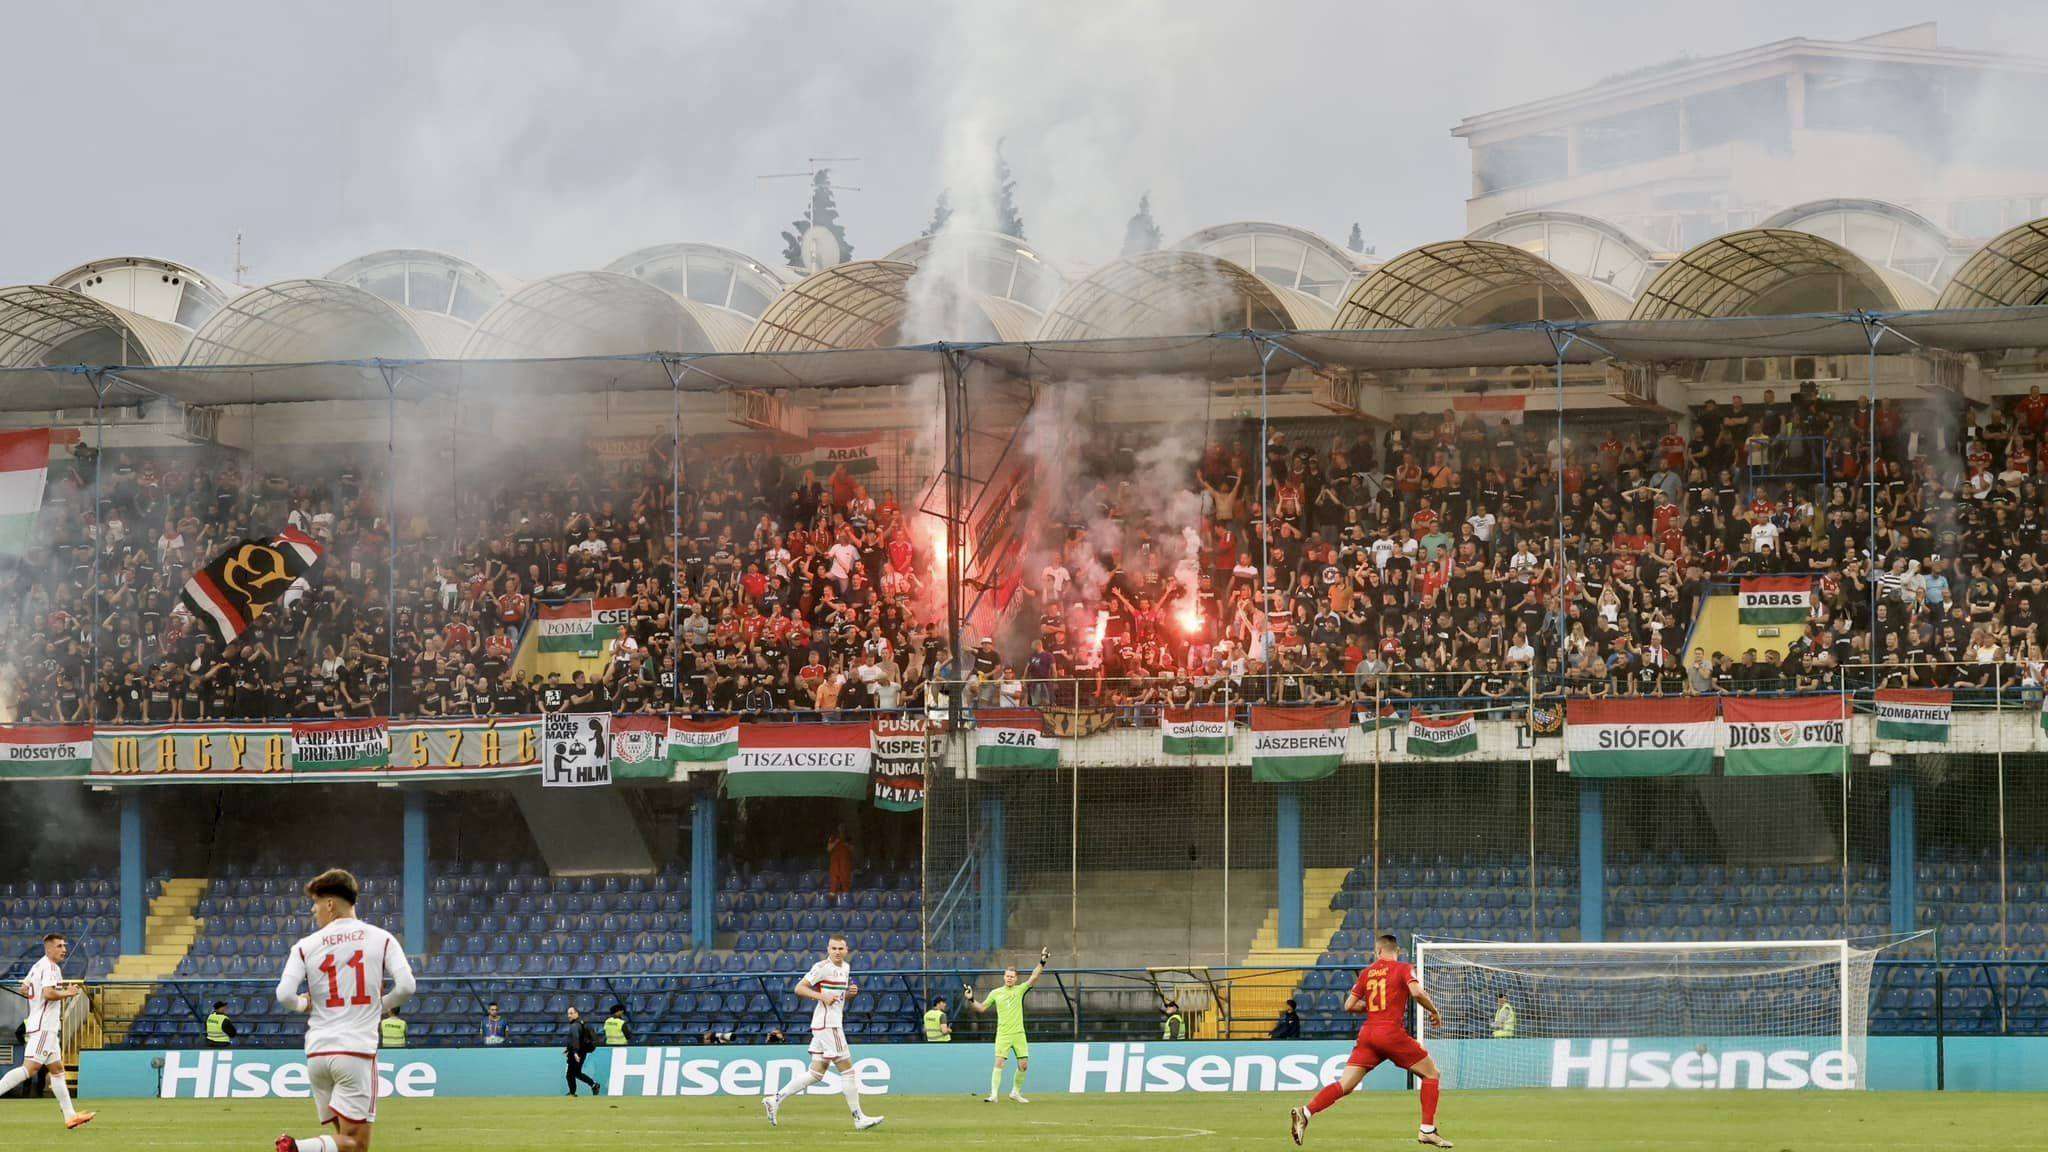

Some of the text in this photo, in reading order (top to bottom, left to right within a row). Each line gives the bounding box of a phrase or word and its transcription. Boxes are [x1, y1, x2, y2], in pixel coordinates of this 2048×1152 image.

[827, 447, 868, 460] ARAK
[1746, 595, 1802, 605] DABAS
[545, 714, 569, 723] HUN
[545, 722, 578, 731] LOVES
[545, 731, 577, 740] MARY
[997, 731, 1036, 746] SZÁR
[1599, 725, 1685, 748] SIÓFOK
[1803, 720, 1844, 745] GYŐR
[1255, 734, 1346, 750] JÁSZBERÉNY
[299, 745, 360, 761] BRIGADE
[742, 753, 856, 767] TISZACSEGE
[576, 766, 608, 783] HLM
[322, 930, 365, 946] KERKEZ
[319, 949, 372, 1008] 11
[1366, 977, 1387, 1012] 21
[607, 1046, 890, 1096] Hisense
[1069, 1043, 1364, 1093] Hisense
[1551, 1038, 1858, 1089] Hisense
